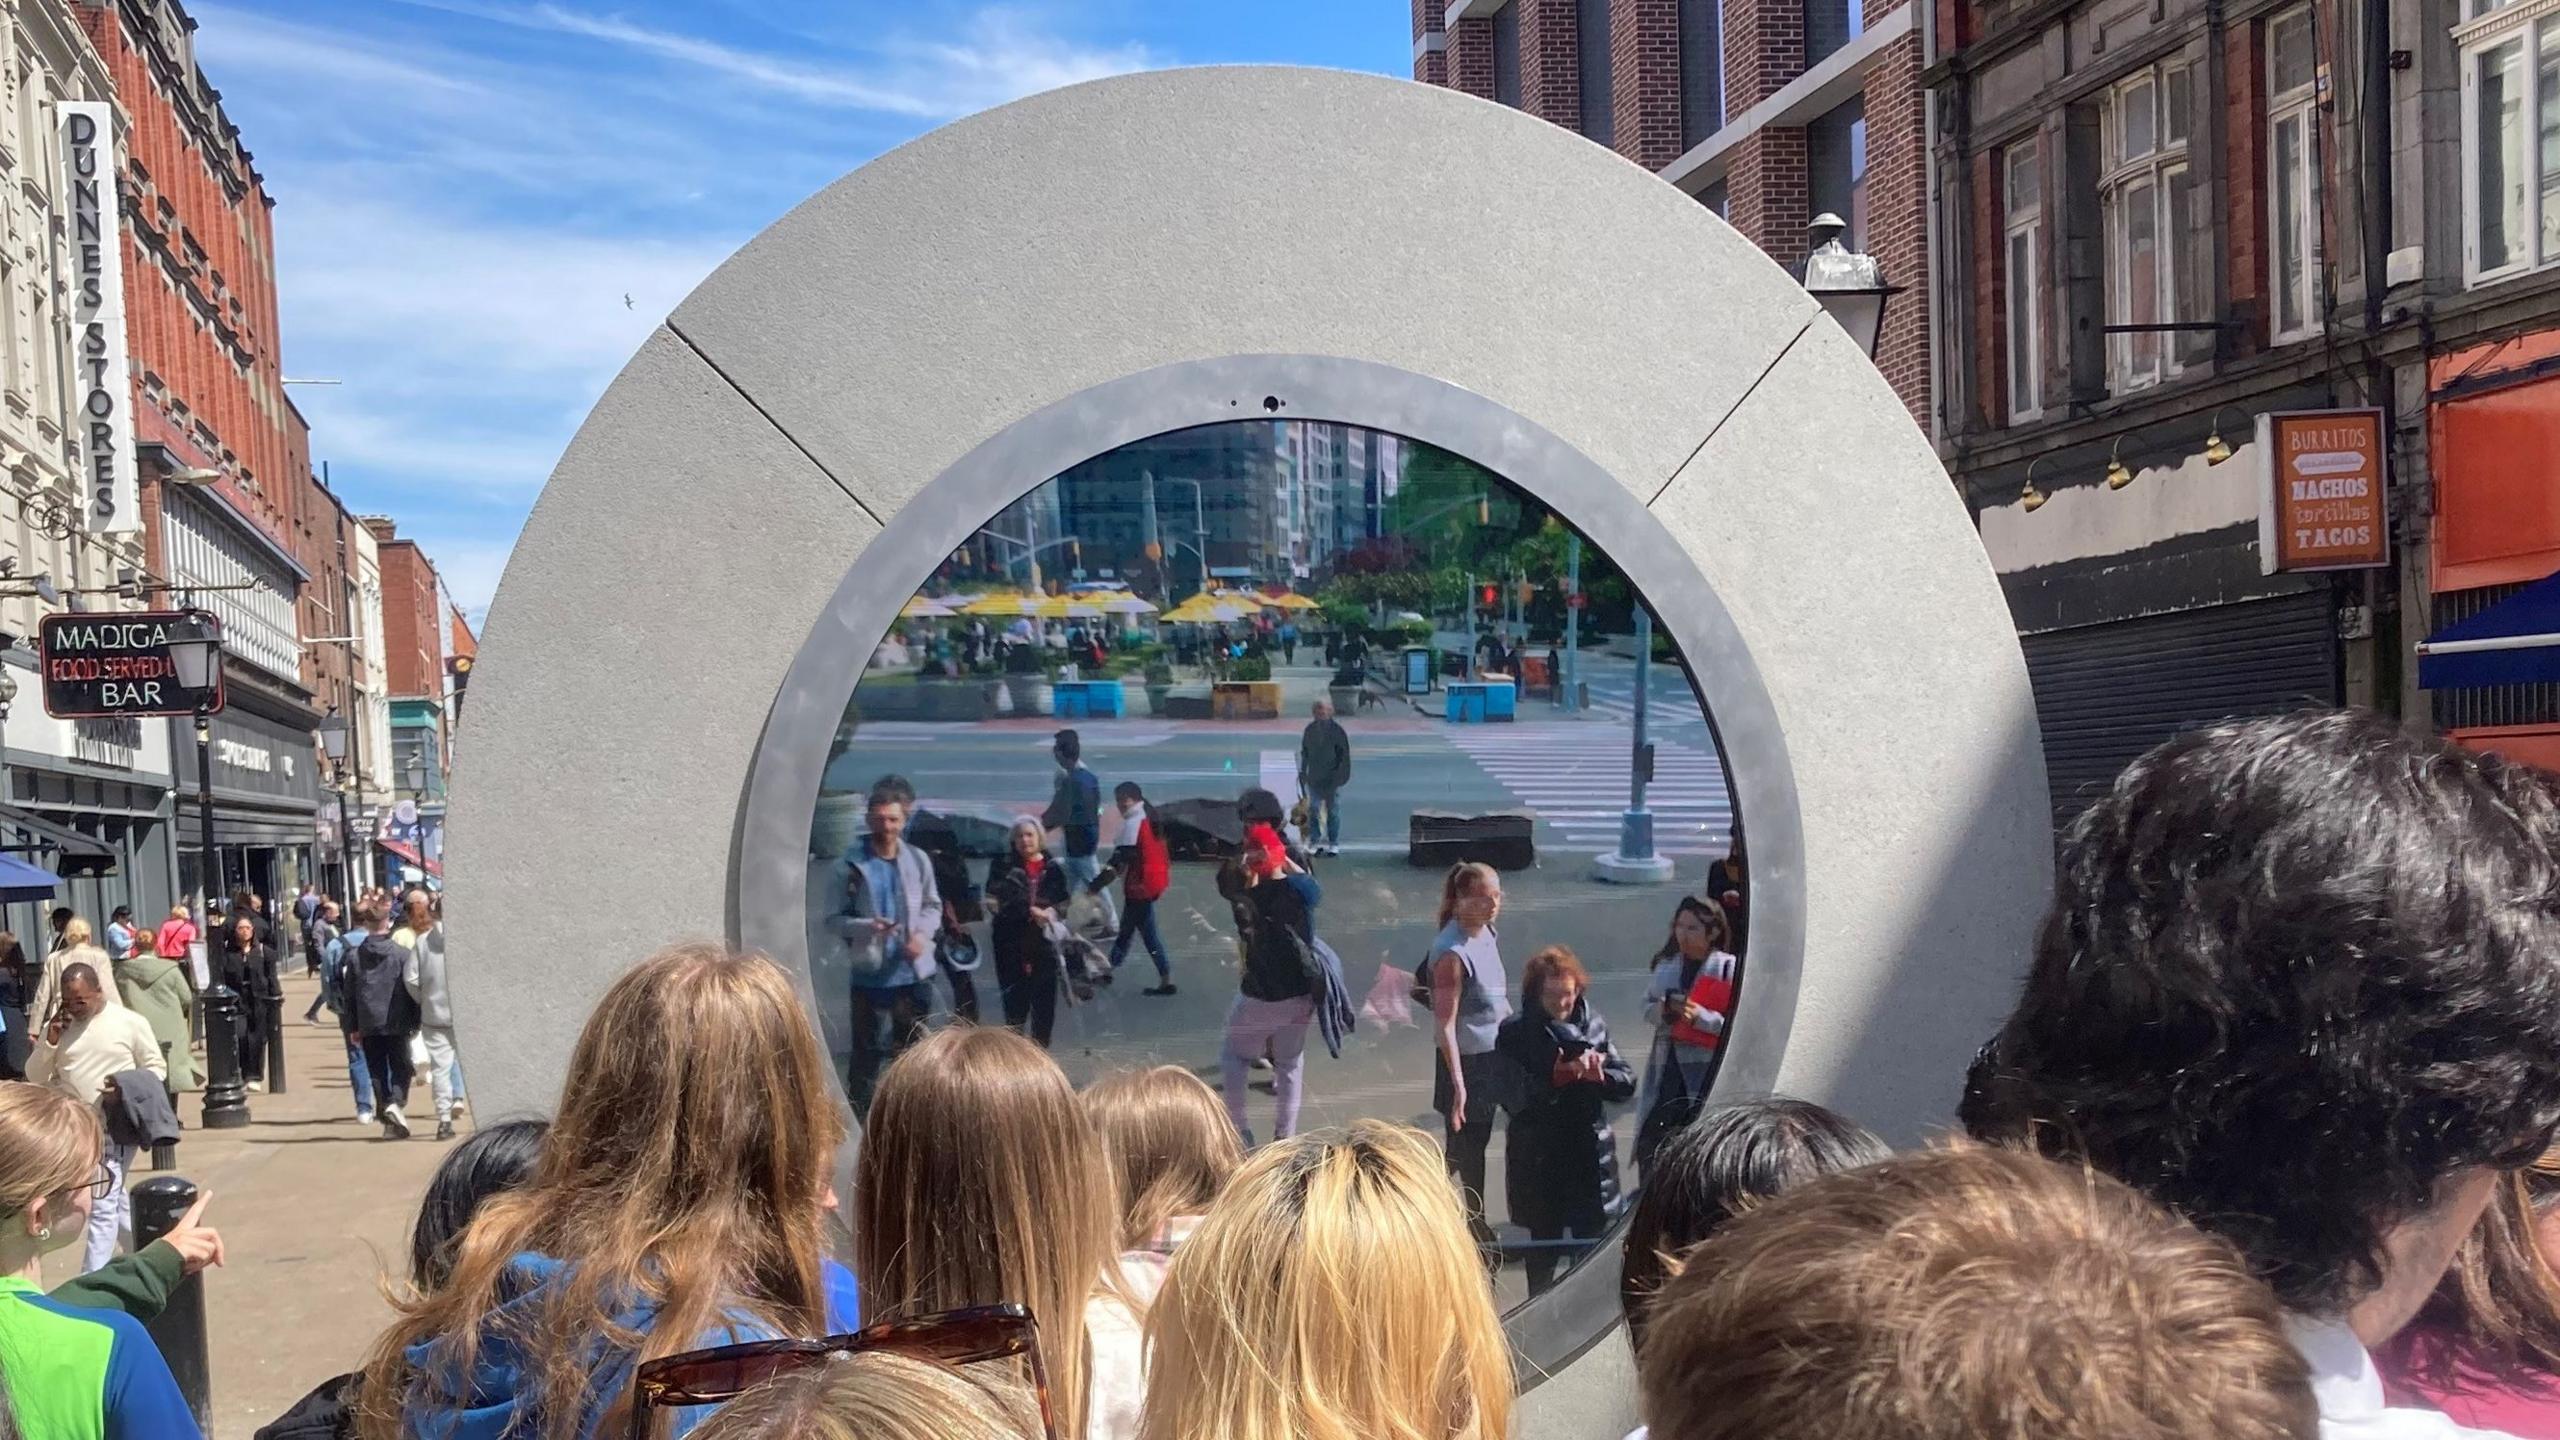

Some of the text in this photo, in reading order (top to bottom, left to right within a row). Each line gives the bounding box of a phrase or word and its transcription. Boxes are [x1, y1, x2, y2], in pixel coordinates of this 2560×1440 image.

[69, 113, 116, 517] DUNNES STORES
[2291, 428, 2367, 450] BURRITOS
[2291, 477, 2369, 501] NACHOS
[2295, 501, 2370, 523] tortillas
[2295, 526, 2370, 549] TACOS
[56, 624, 168, 650] MADIGA
[51, 658, 99, 681] FOOD
[103, 656, 163, 680] SERVED
[102, 681, 163, 707] BAR
